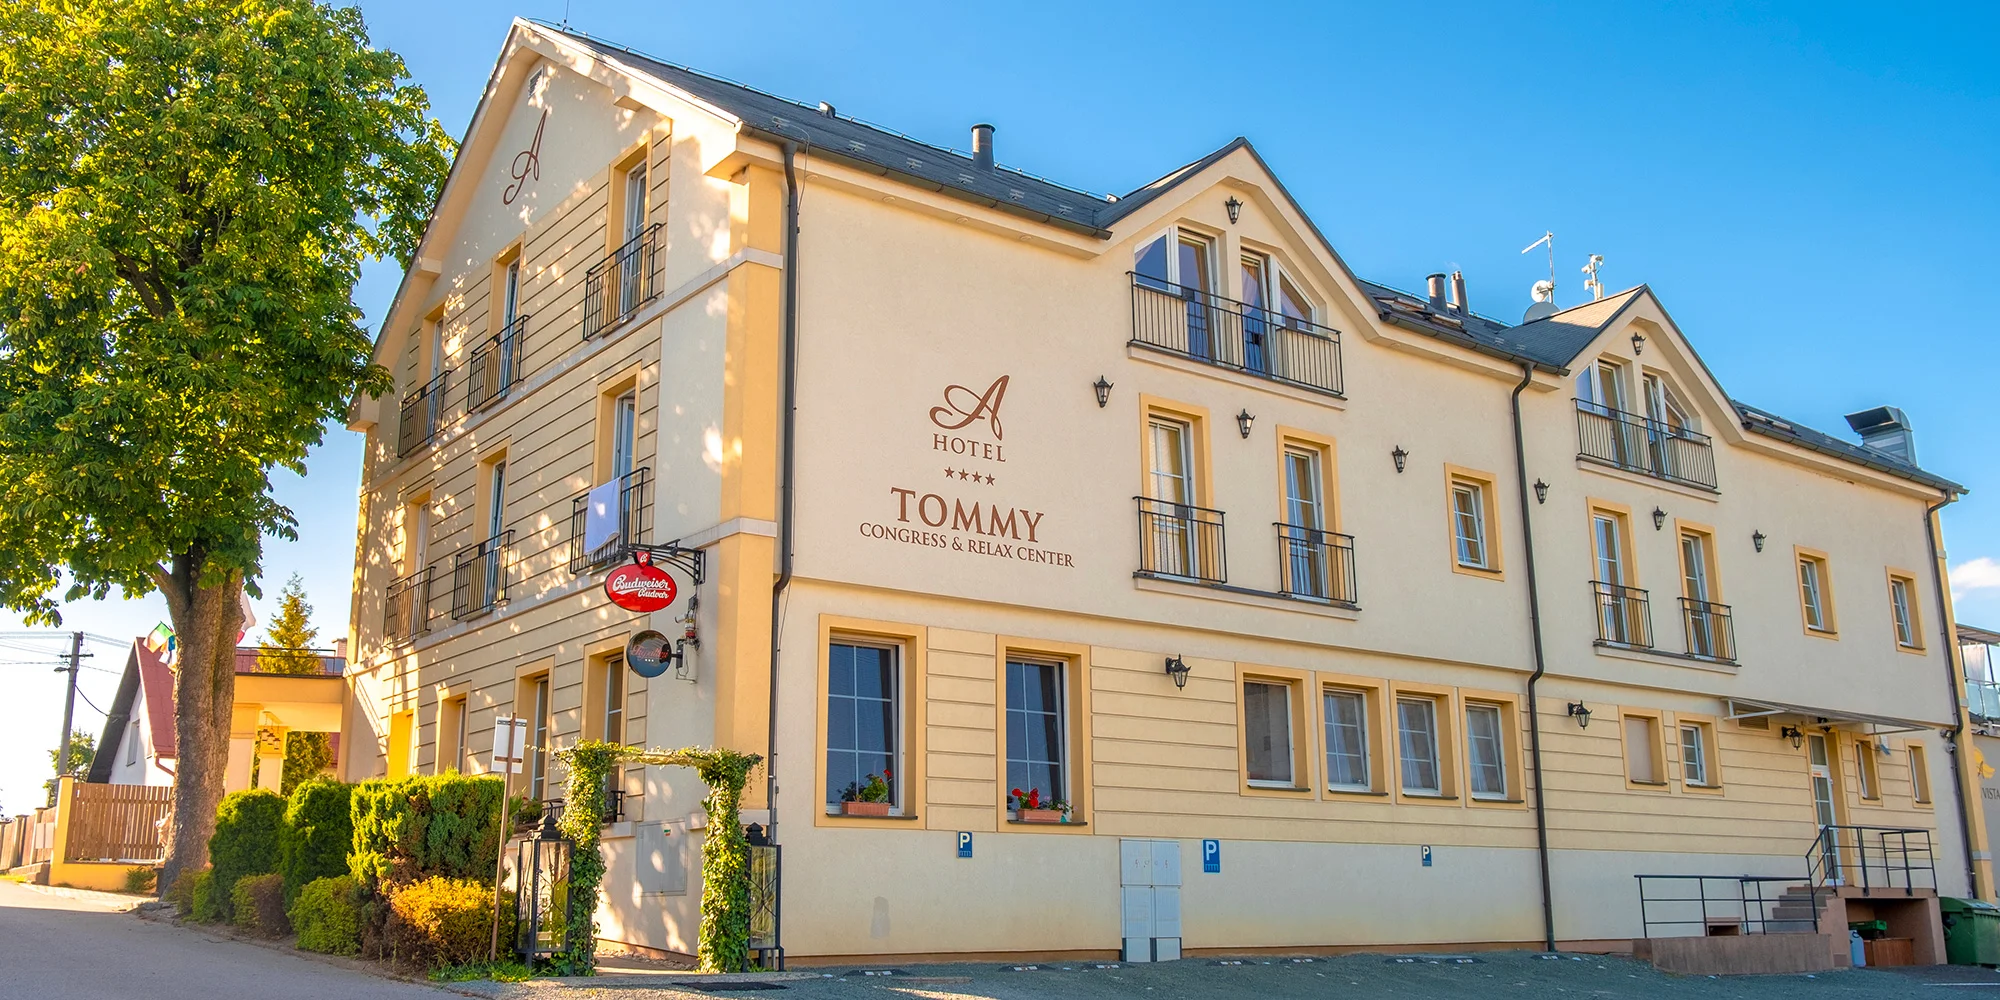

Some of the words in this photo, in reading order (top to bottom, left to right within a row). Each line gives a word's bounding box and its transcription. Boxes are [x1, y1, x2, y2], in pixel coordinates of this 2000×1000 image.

[929, 374, 1010, 441] A
[932, 433, 1006, 463] HOTEL
[890, 486, 1044, 543] TOMMY
[859, 522, 947, 549] CONGRESS
[951, 536, 964, 551] &
[968, 539, 1013, 559] RELAX
[1016, 546, 1075, 568] CENTER
[612, 574, 671, 595] Budweiser
[638, 588, 669, 599] Budvar
[960, 832, 970, 849] P
[1205, 841, 1217, 861] P
[1422, 846, 1430, 860] P
